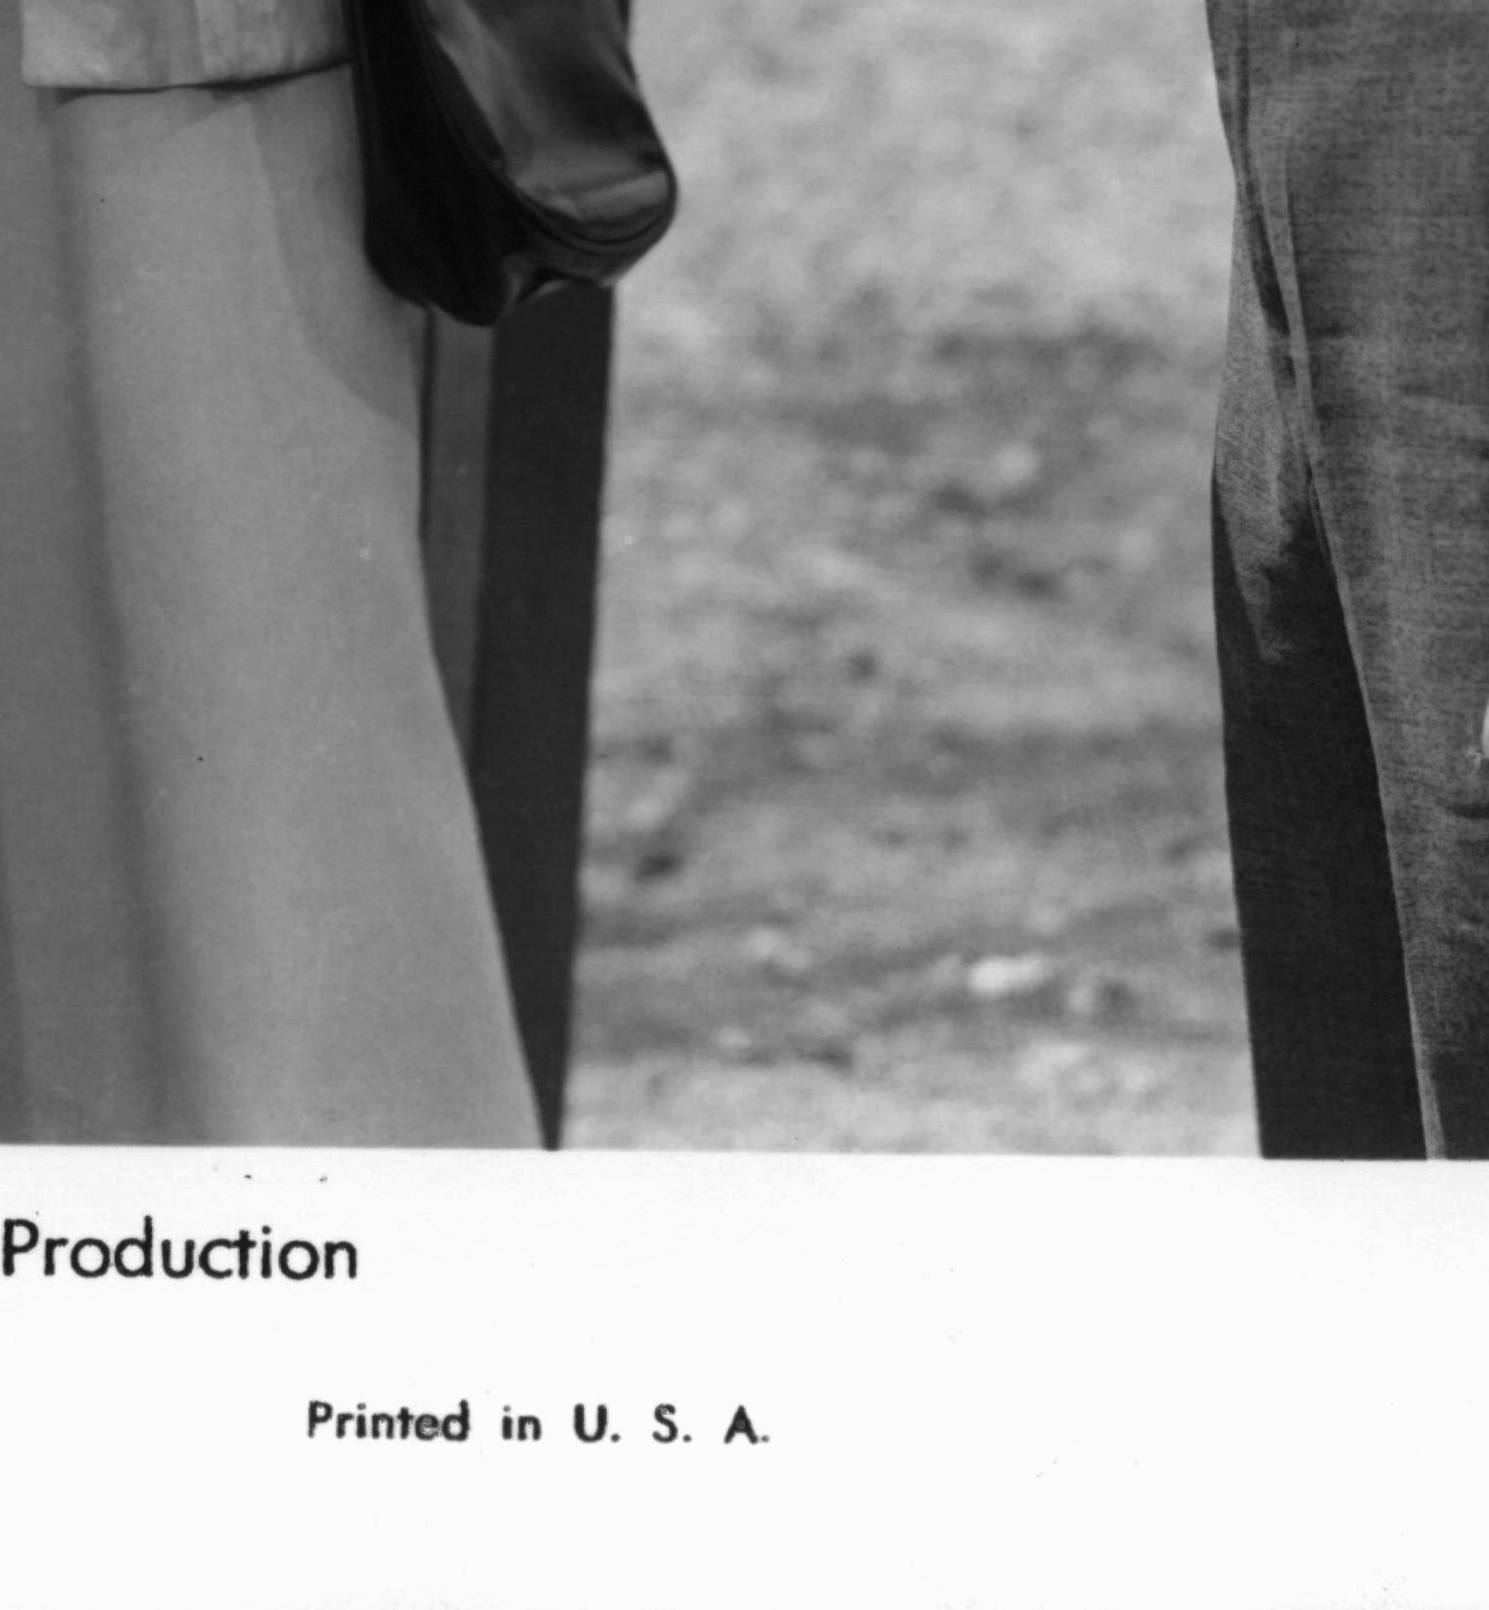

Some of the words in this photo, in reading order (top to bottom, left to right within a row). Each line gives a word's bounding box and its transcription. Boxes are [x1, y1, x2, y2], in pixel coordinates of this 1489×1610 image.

[2, 1213, 358, 1281] Production
[306, 1399, 471, 1443] Printed
[501, 1403, 542, 1442] in
[573, 1403, 621, 1444] U.
[652, 1403, 692, 1444] S.
[723, 1404, 770, 1445] A.
